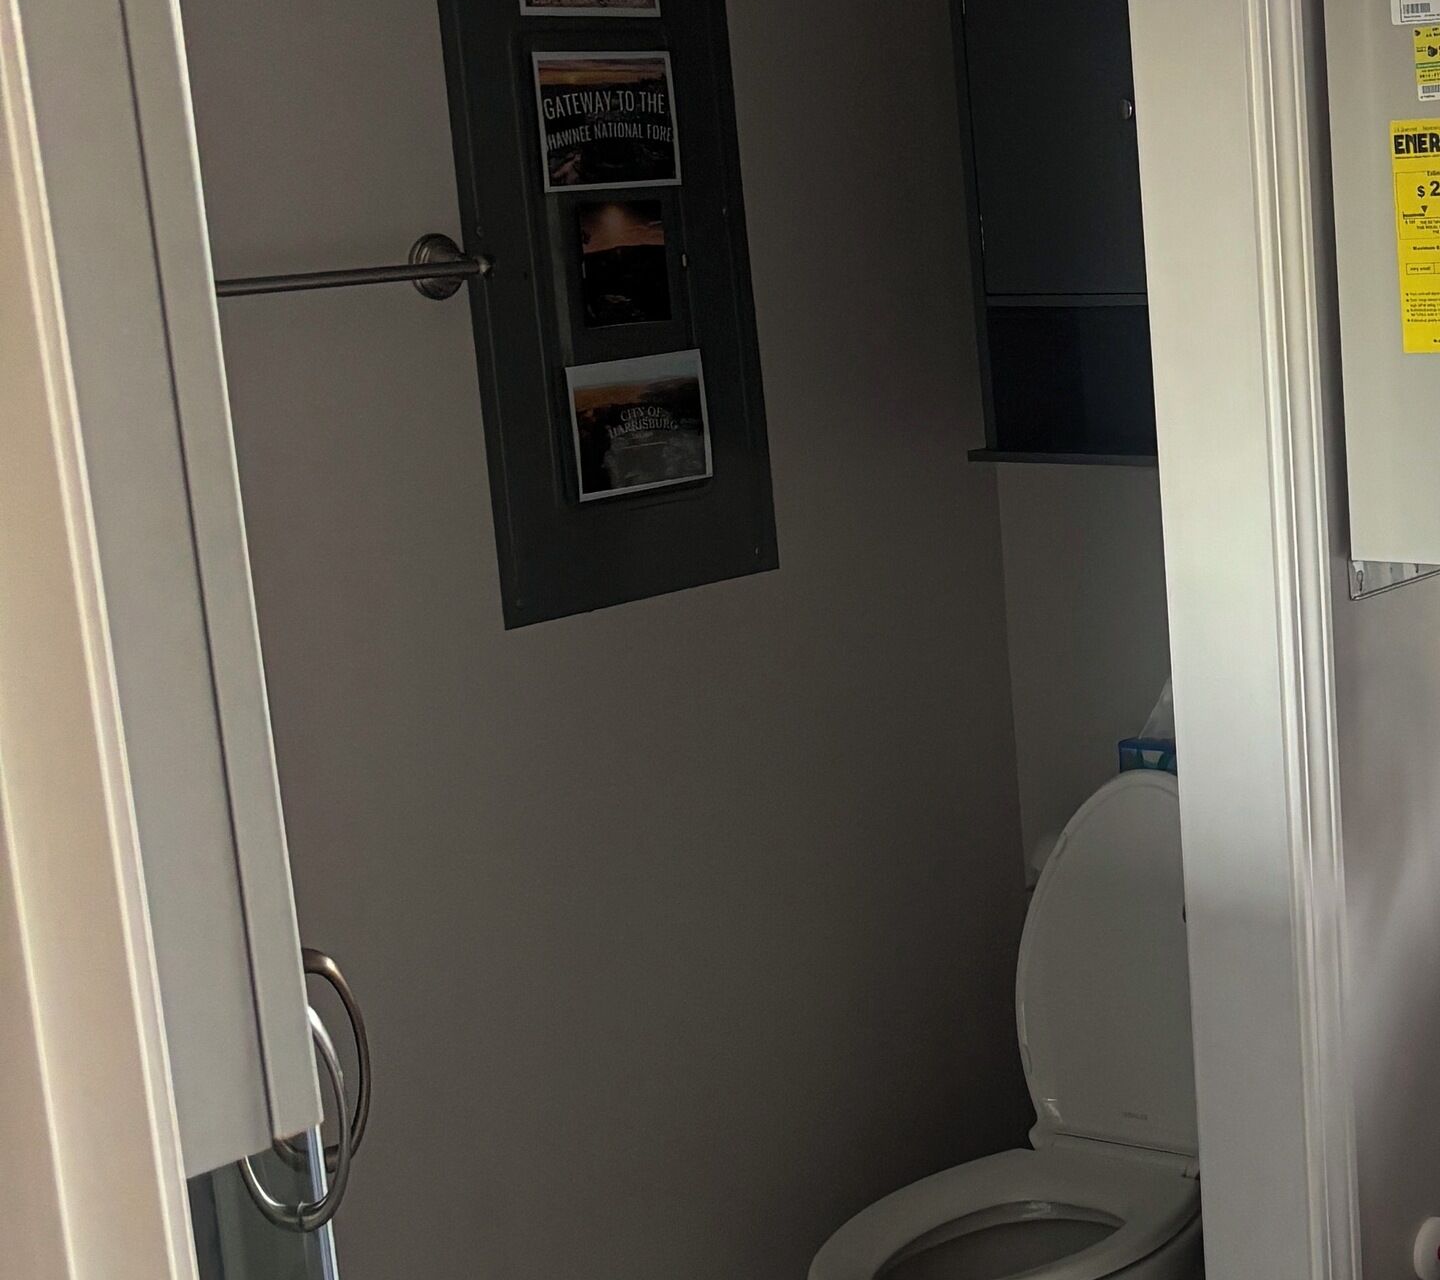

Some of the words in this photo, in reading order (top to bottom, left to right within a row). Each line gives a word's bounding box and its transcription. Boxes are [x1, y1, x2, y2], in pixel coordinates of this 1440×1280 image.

[543, 90, 612, 120] GATEWAY
[616, 90, 635, 112] TO
[638, 91, 665, 114] THE
[594, 122, 644, 139] NATIONAL
[647, 124, 674, 143] FORE
[1417, 185, 1426, 198] $
[620, 406, 646, 422] CITY
[647, 405, 663, 417] OF
[608, 417, 679, 439] HARRISBURG
